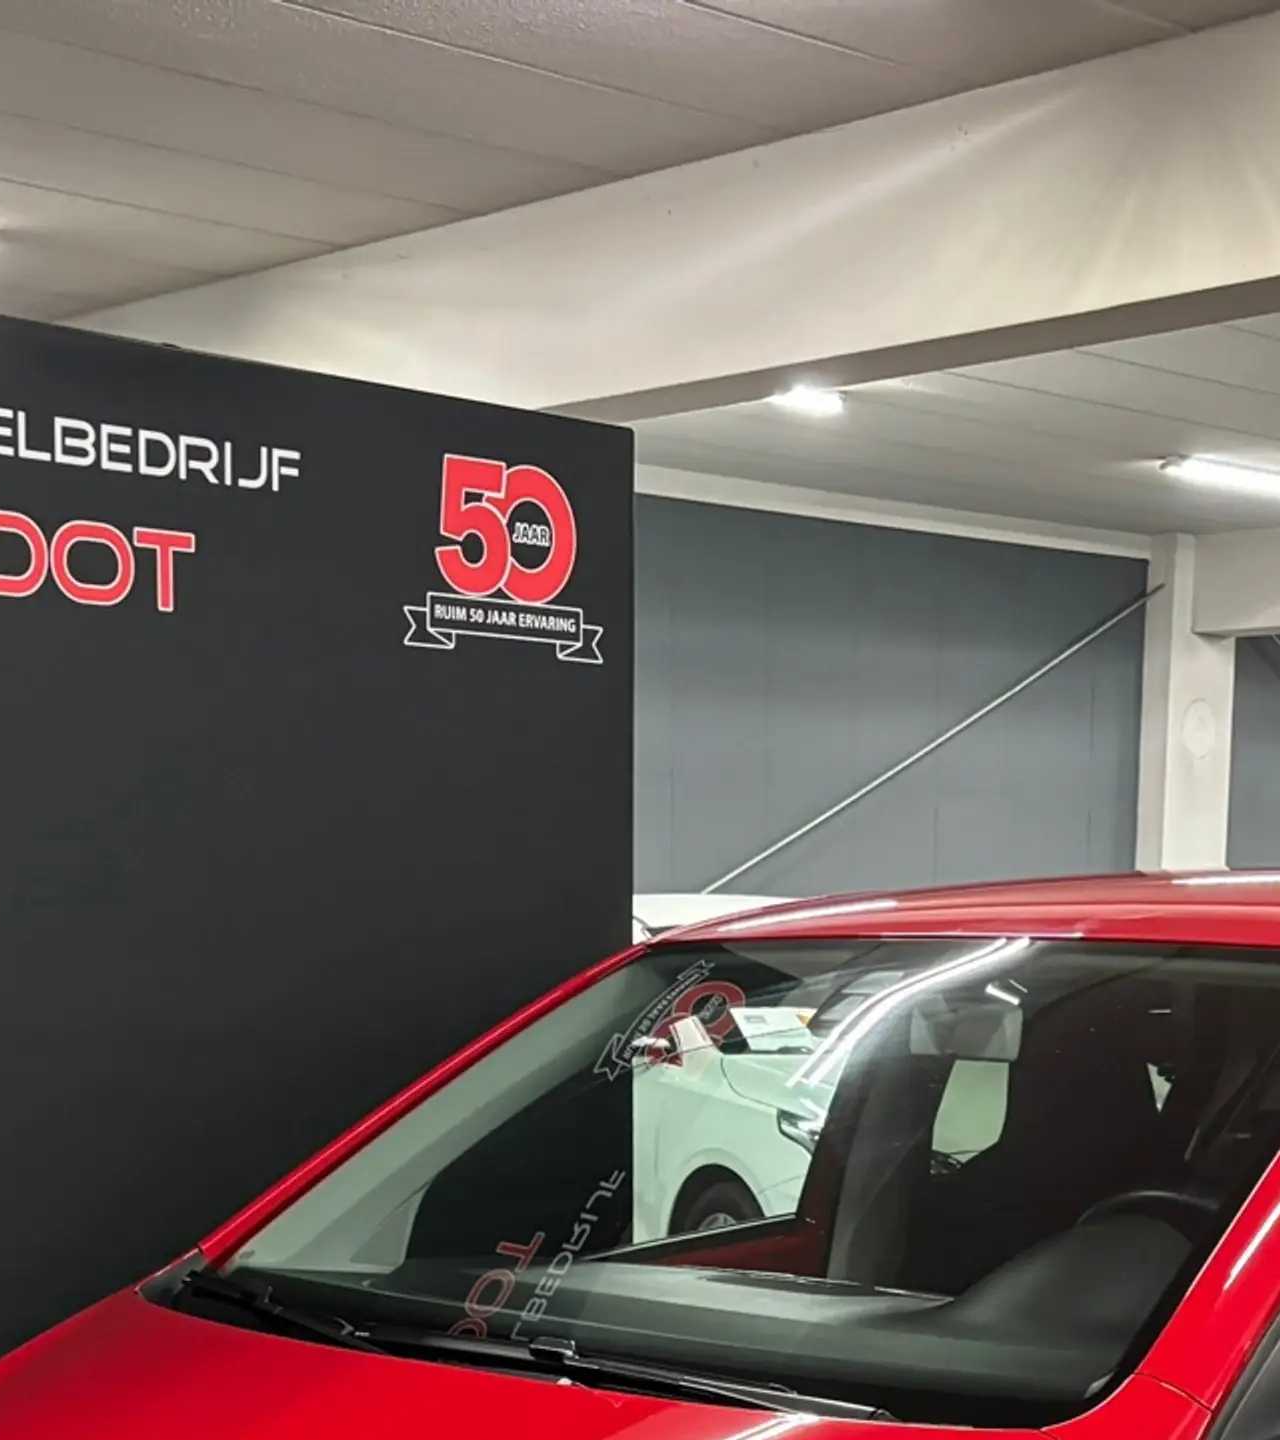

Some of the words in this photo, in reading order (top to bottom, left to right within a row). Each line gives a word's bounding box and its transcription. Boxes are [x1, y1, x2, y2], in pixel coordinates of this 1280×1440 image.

[434, 453, 578, 605] 50
[512, 521, 551, 547] JAAR
[433, 603, 468, 621] RUIM
[469, 607, 485, 624] 50
[486, 609, 517, 627] JAAR
[518, 613, 576, 633] ERVARING
